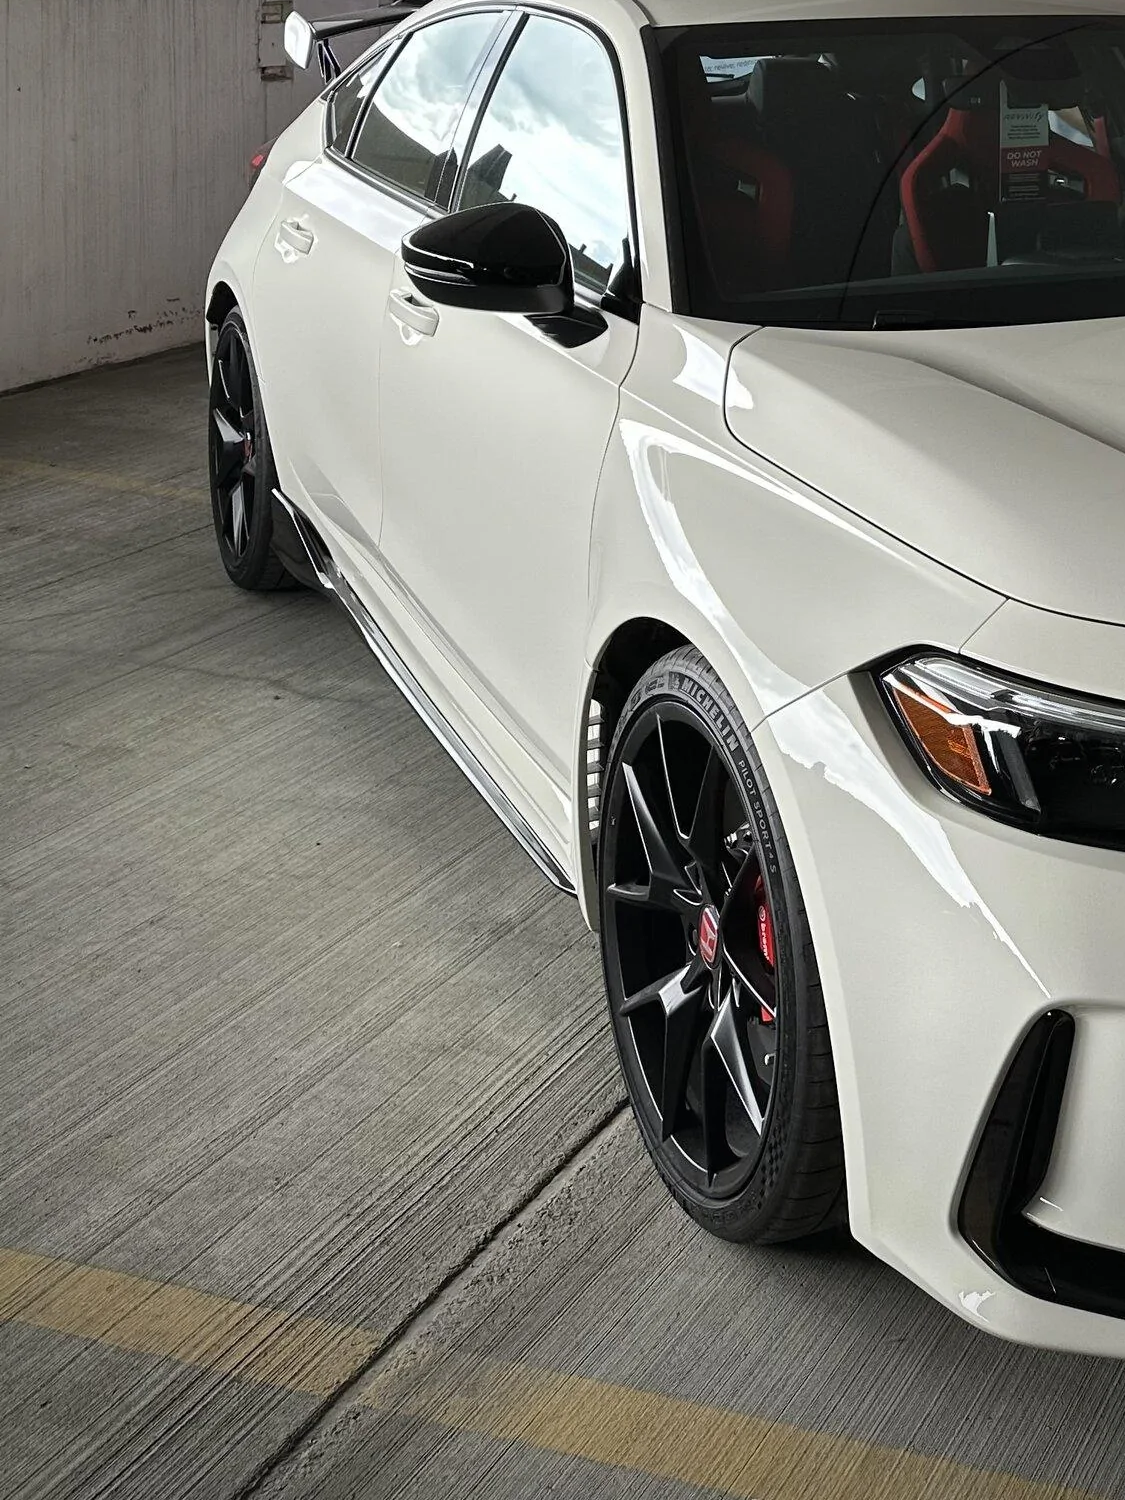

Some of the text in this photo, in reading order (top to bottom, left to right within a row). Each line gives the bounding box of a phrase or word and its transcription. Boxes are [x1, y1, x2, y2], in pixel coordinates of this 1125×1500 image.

[1007, 150, 1042, 161] DO NOT
[1011, 159, 1039, 168] WASH
[681, 677, 740, 753] MICHELIN
[738, 759, 757, 796] PILOT
[752, 801, 773, 850] SPORT
